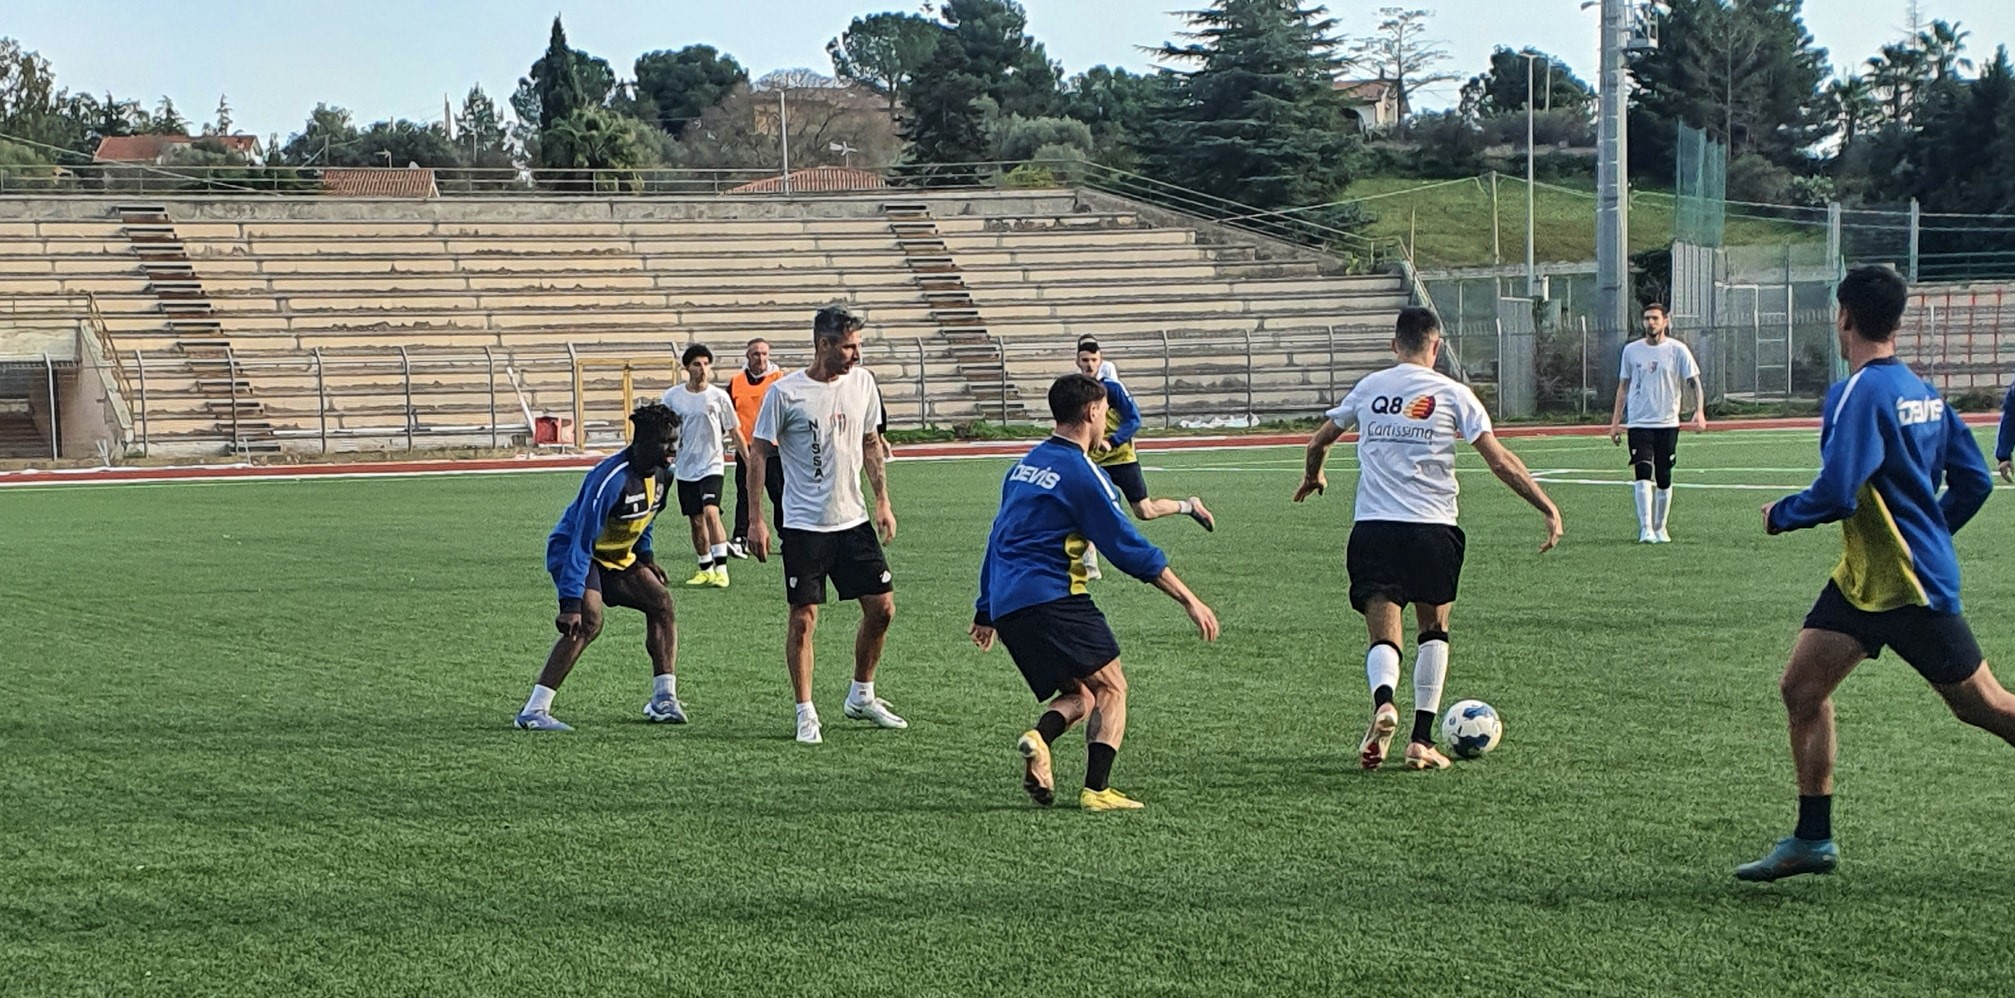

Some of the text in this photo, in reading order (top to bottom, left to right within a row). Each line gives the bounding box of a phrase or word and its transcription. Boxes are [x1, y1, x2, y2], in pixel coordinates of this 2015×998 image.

[1371, 396, 1403, 414] Q8
[808, 418, 824, 478] NISSA
[1009, 464, 1061, 490] DEVIS
